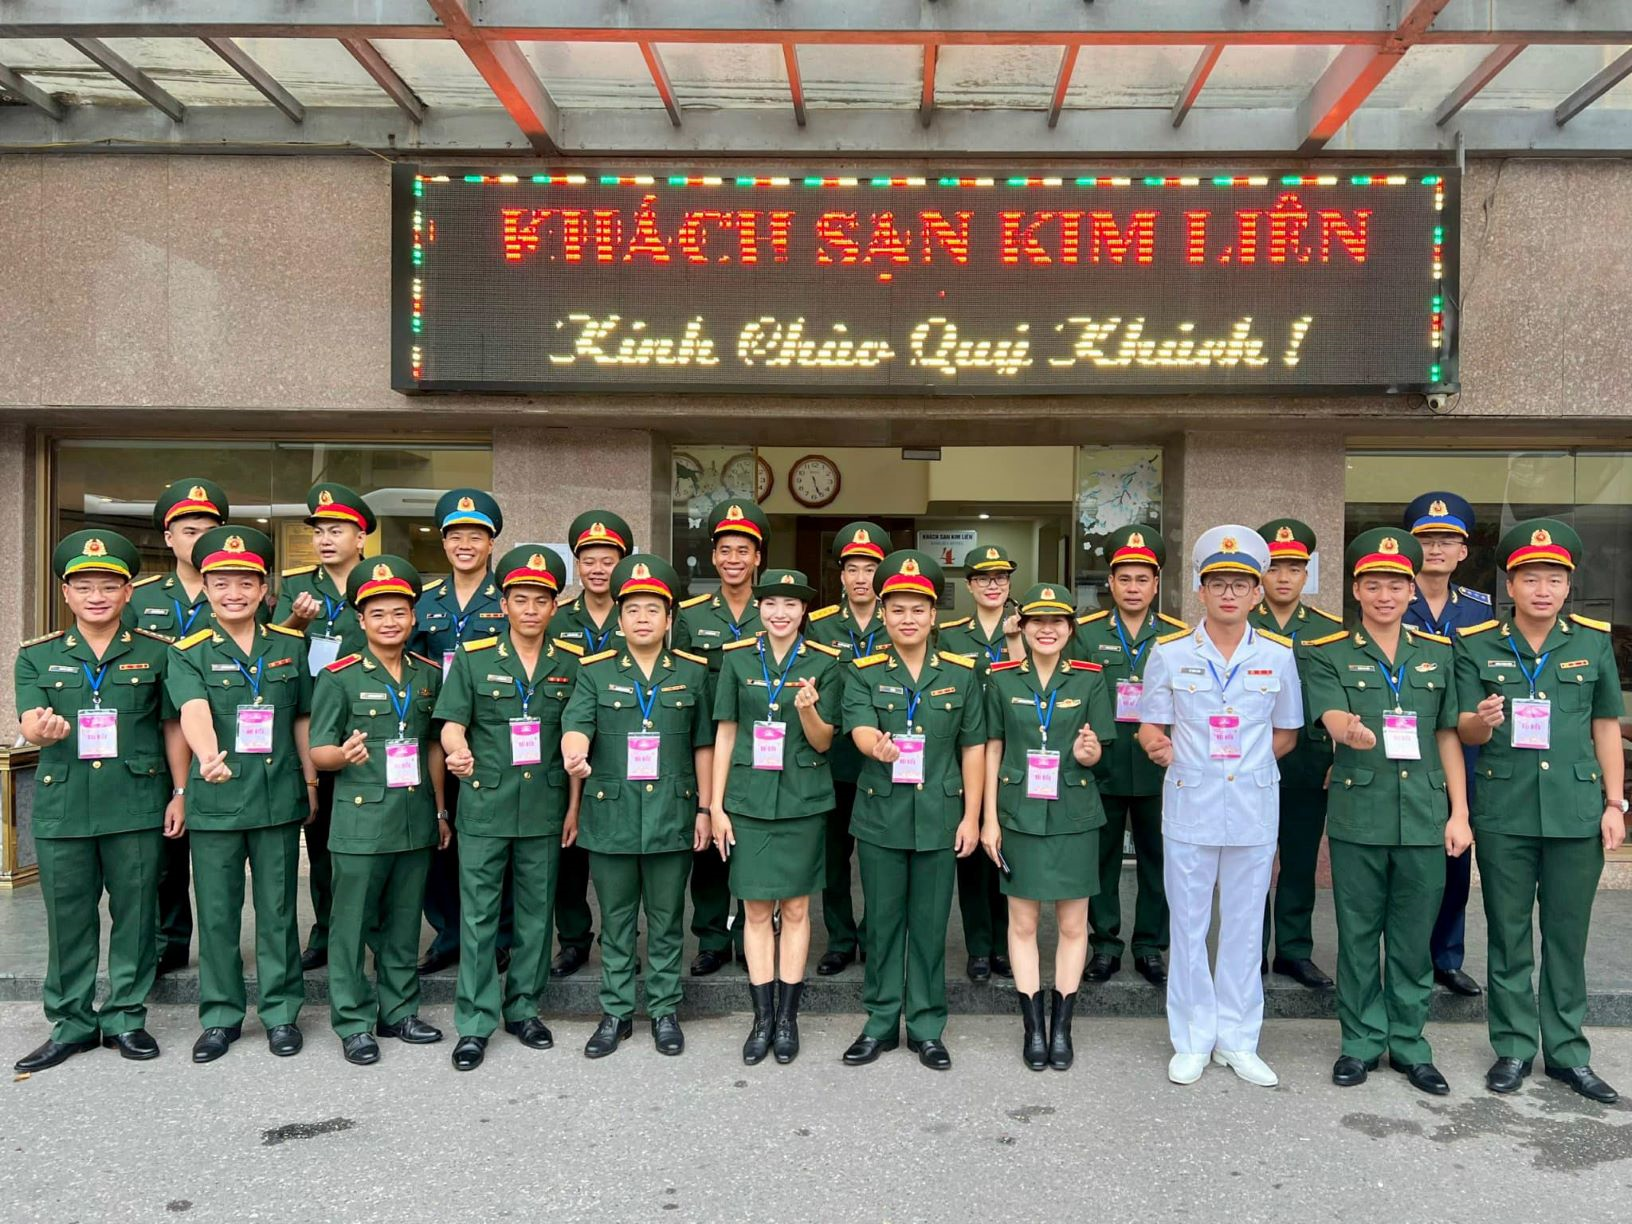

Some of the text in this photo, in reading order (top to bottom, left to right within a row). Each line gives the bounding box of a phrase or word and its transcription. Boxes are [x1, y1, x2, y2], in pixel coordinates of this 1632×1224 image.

[814, 209, 974, 282] SẠN
[997, 209, 1161, 267] KIM
[1183, 192, 1373, 267] LIÊN
